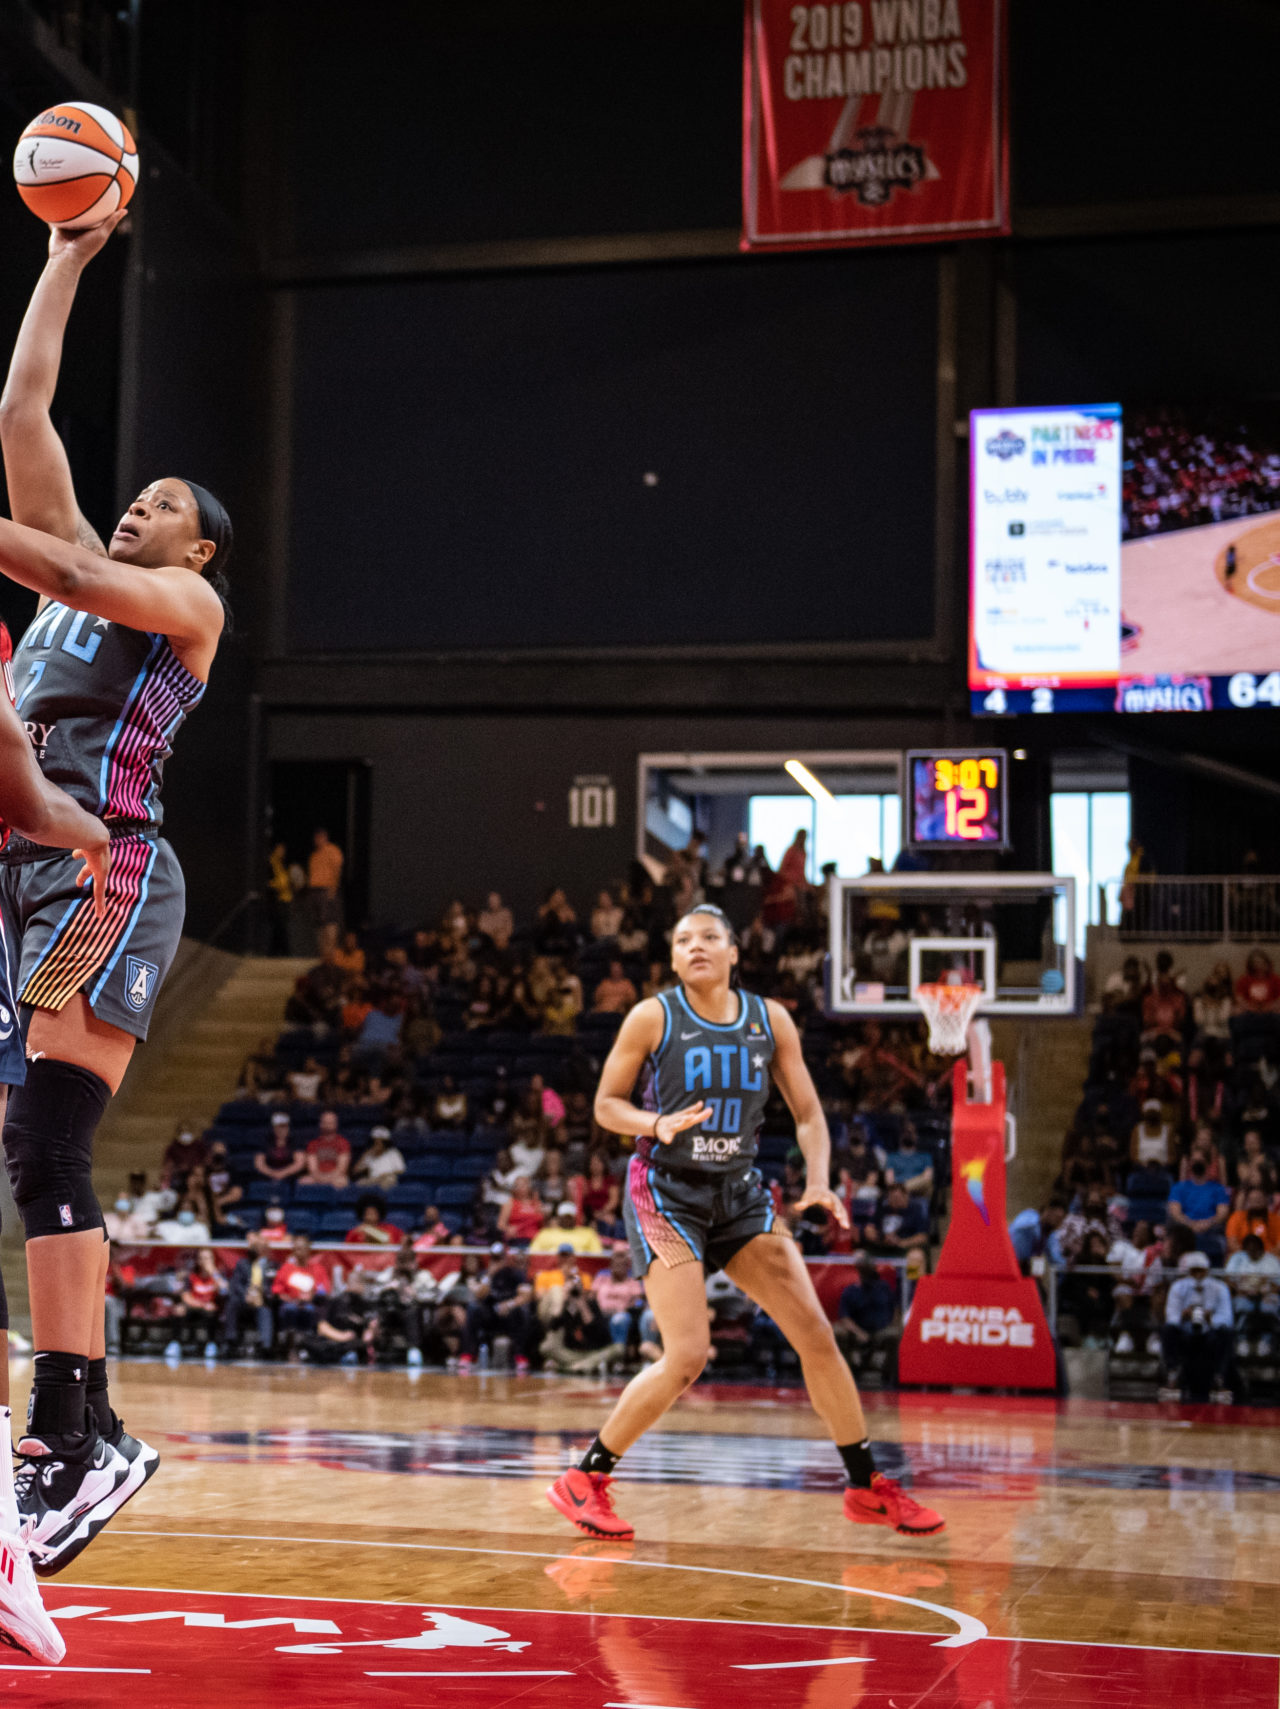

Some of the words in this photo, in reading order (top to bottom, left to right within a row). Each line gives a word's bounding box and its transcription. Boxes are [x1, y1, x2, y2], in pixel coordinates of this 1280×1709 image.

[790, 2, 863, 50] 2019
[871, 0, 962, 43] WNBA
[784, 42, 968, 100] CHAMPIONS
[984, 688, 1007, 714] 4
[1031, 687, 1054, 713] 2
[1228, 672, 1280, 708] 64
[934, 758, 998, 792] 3:07
[569, 786, 616, 827] 101
[945, 787, 991, 839] 12
[684, 1044, 762, 1092] ATL
[921, 1319, 1035, 1347] PRIDE
[933, 1305, 1023, 1323] #WNBA
